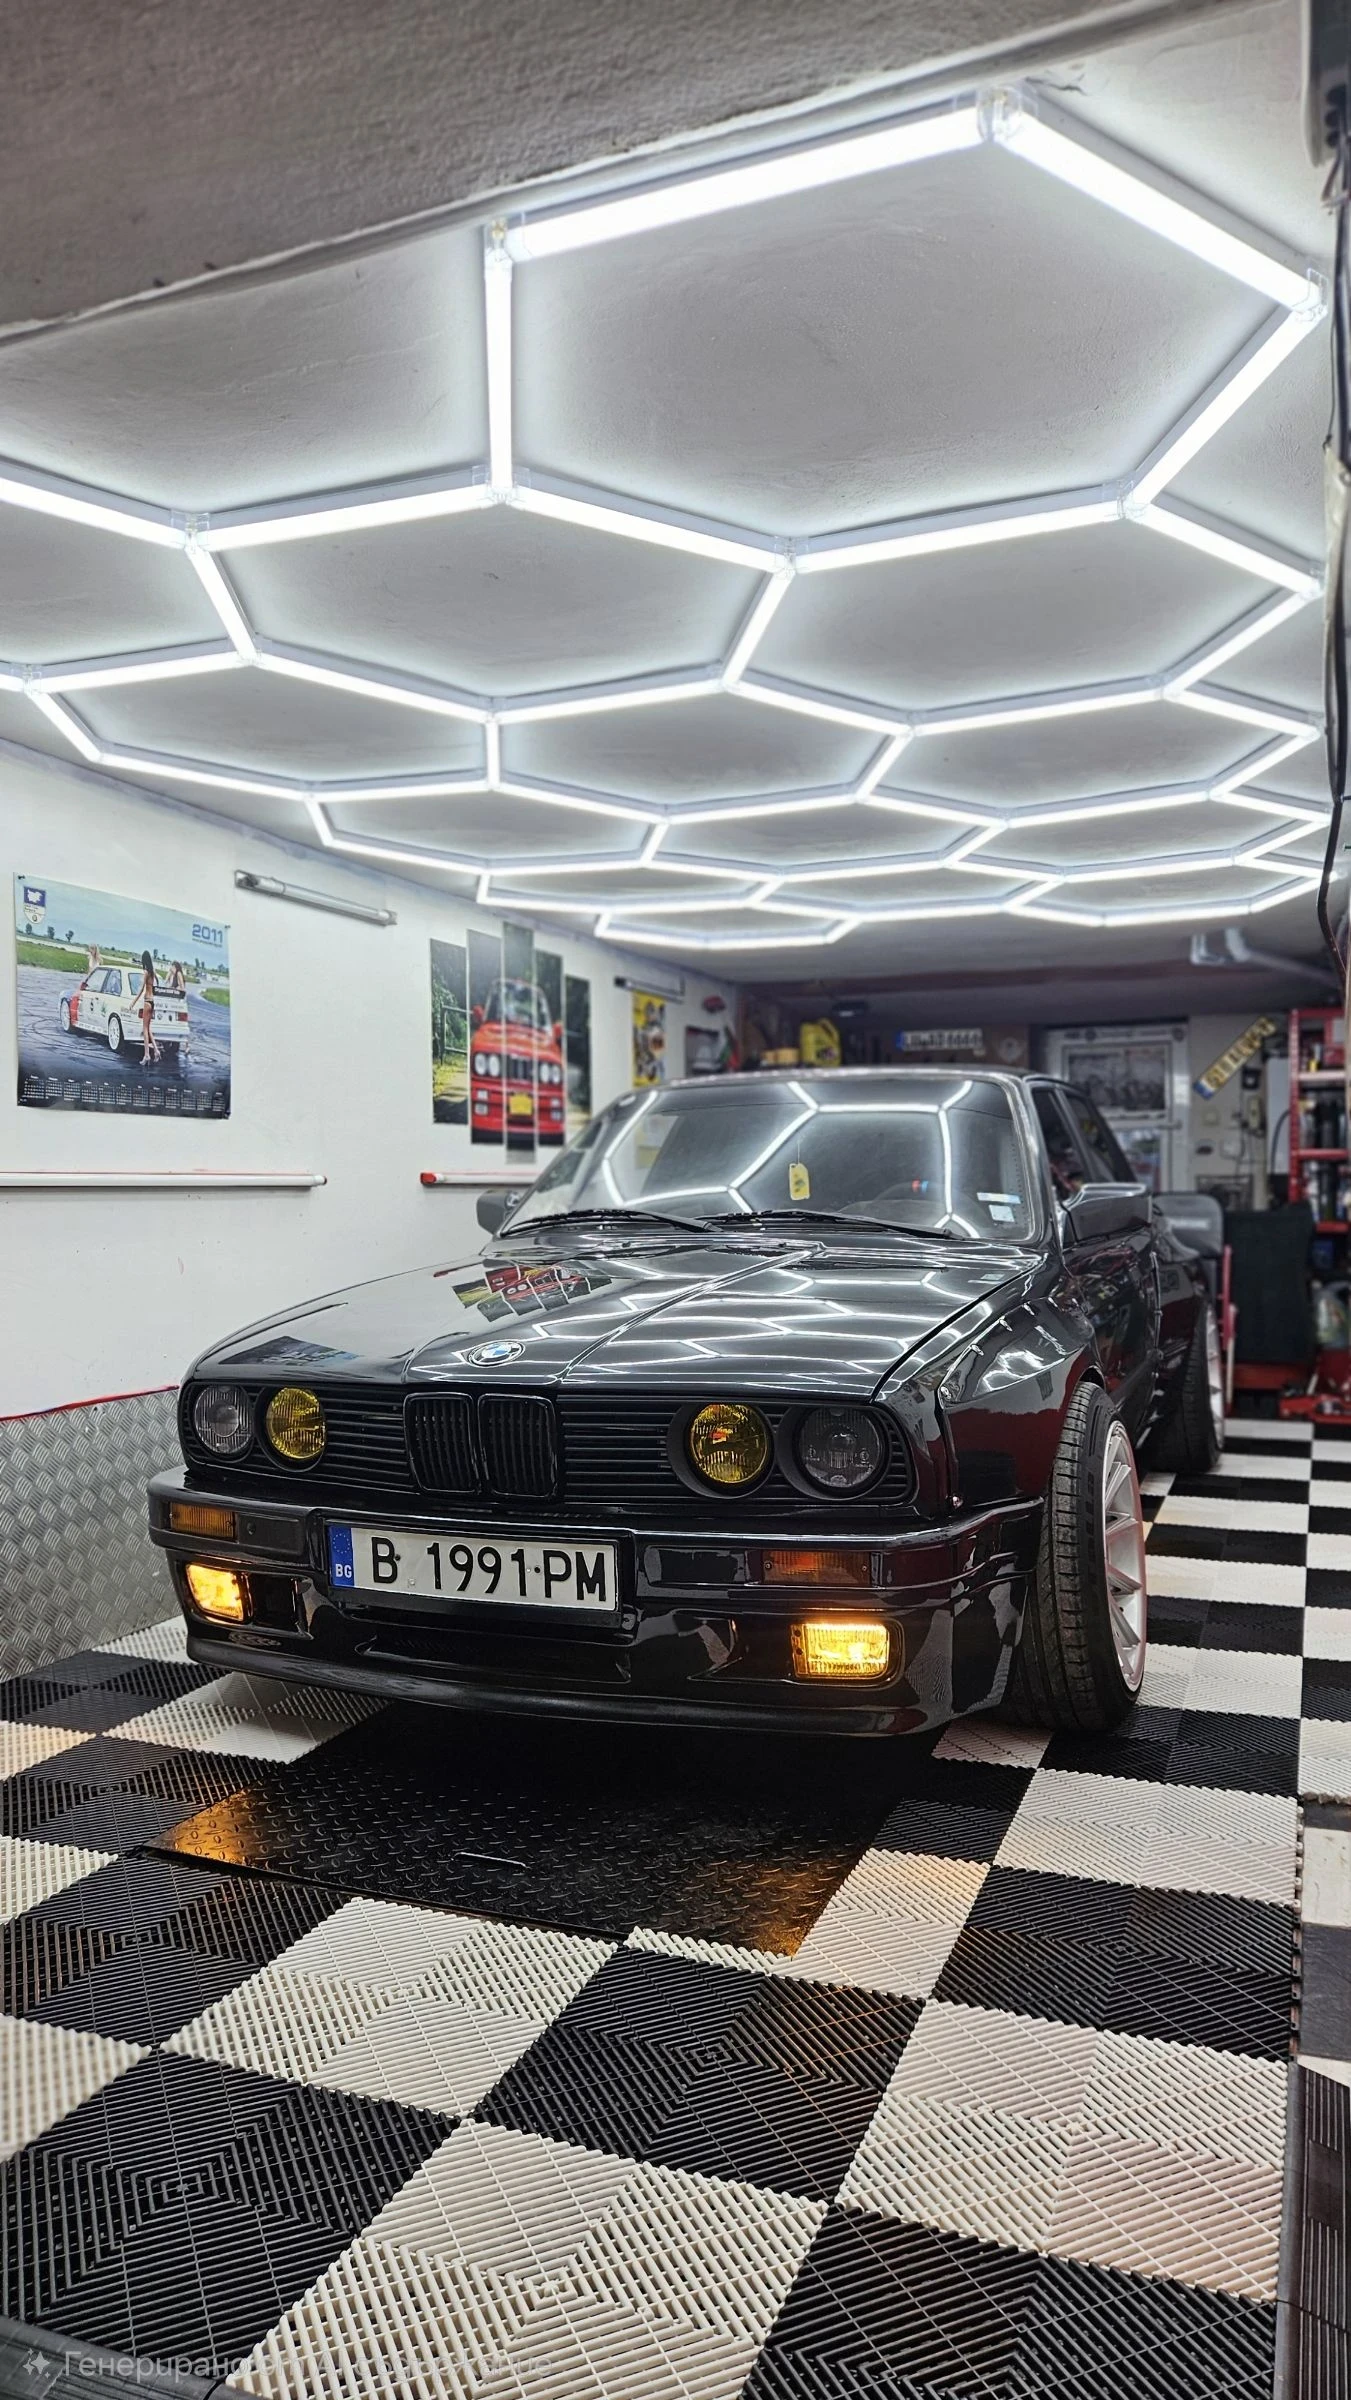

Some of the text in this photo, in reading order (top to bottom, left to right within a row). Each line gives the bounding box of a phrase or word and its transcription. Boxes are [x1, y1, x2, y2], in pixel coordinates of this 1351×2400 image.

[192, 923, 223, 944] 2011
[335, 1563, 352, 1578] BG
[371, 1536, 607, 1602] B 1991 PM
